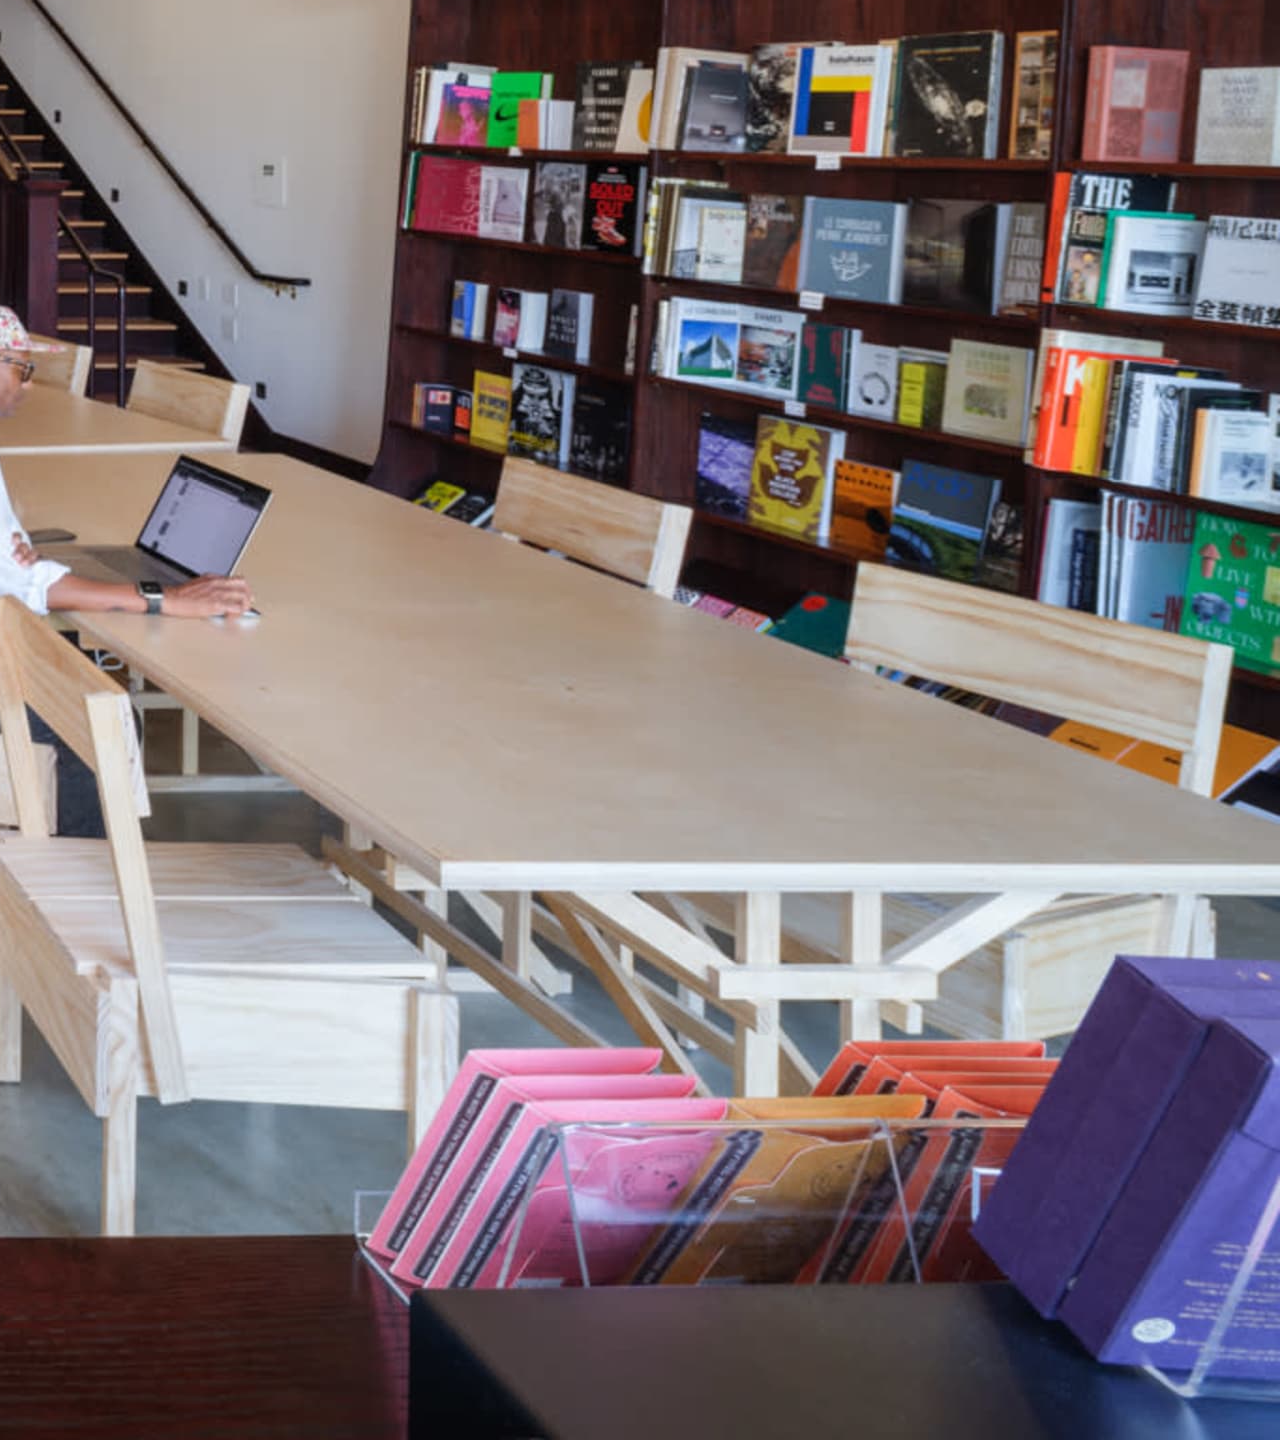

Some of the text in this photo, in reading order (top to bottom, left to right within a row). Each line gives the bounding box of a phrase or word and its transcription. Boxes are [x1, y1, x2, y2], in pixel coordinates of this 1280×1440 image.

[596, 200, 625, 218] OUT
[1082, 175, 1133, 210] THE
[907, 464, 974, 500] Ando
